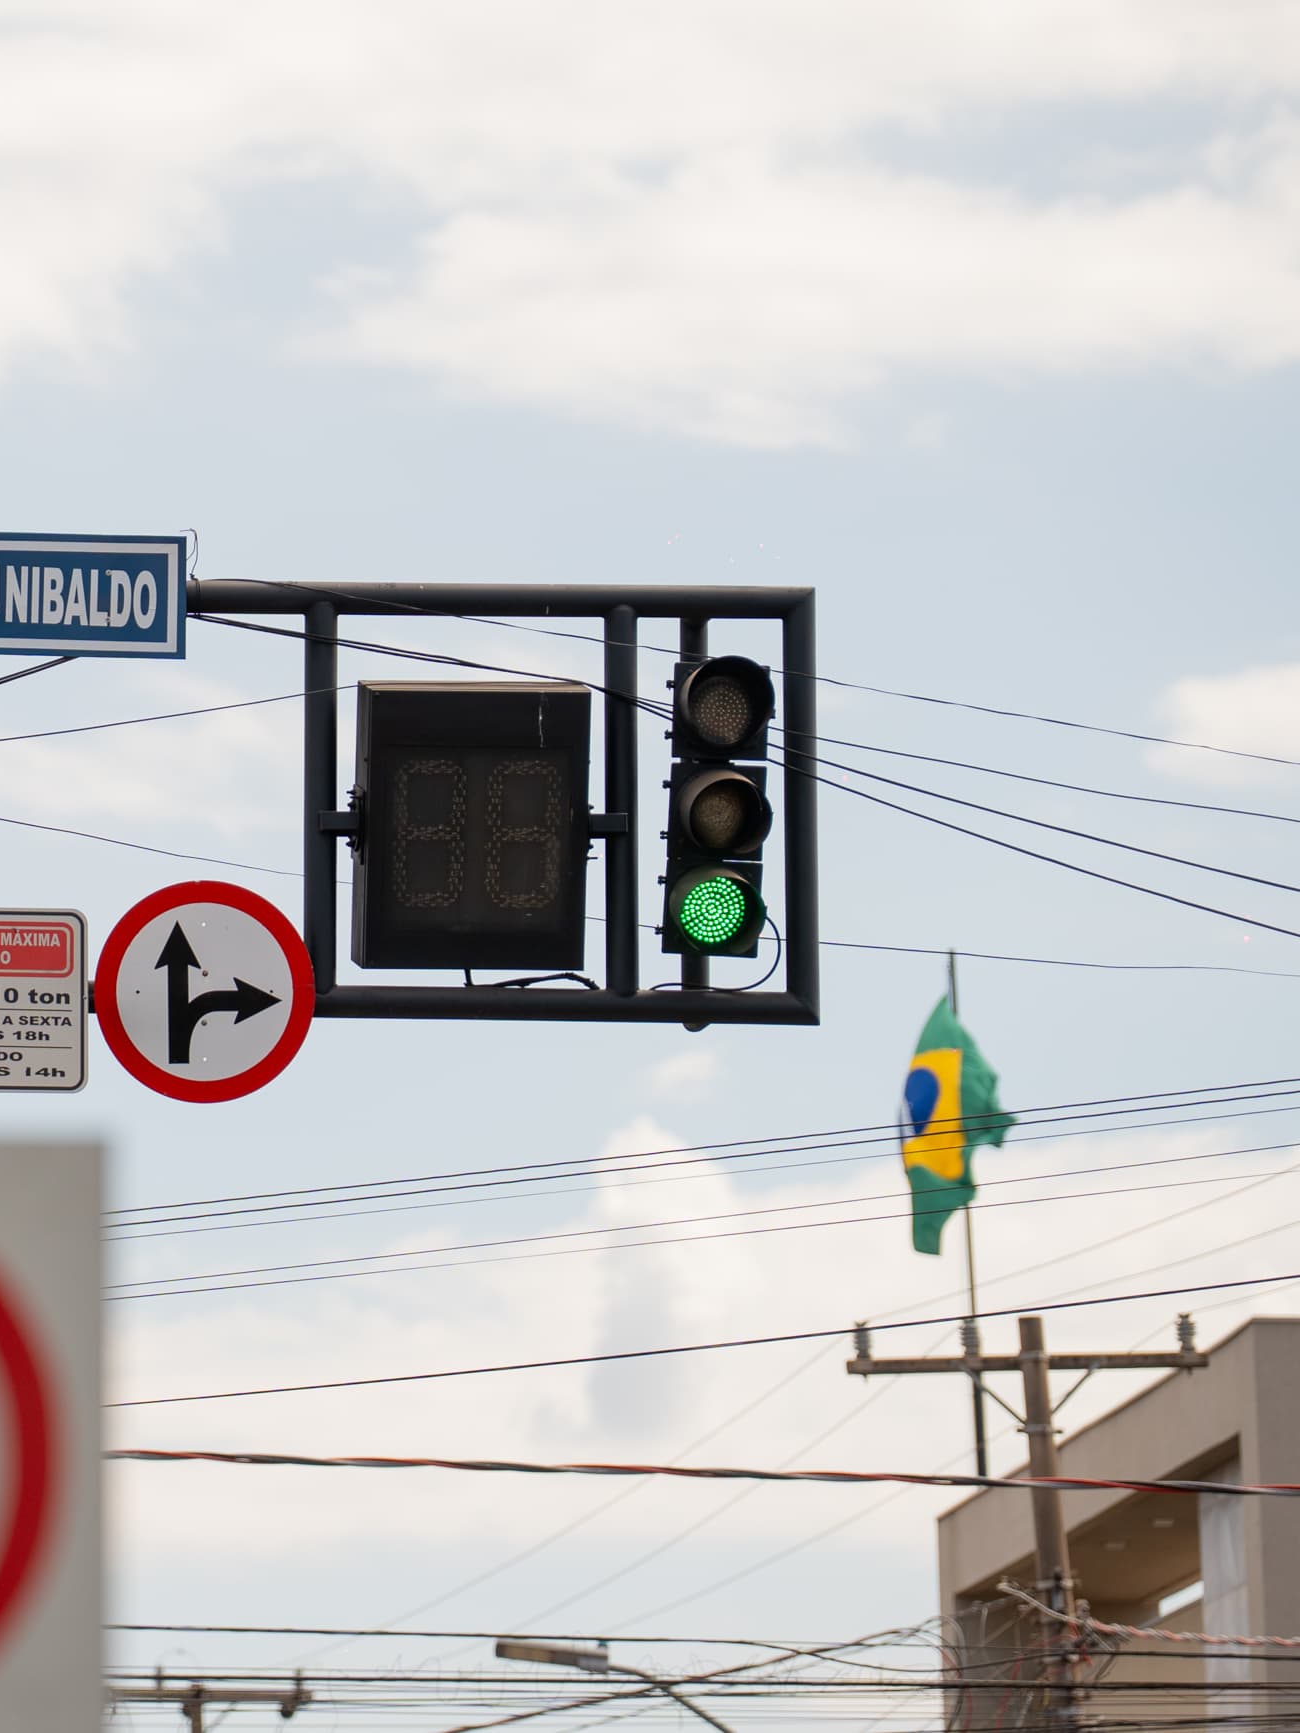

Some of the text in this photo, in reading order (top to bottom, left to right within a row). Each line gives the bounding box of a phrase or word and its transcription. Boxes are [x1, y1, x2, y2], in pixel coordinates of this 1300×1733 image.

[0, 929, 61, 947] MÁXIMA
[28, 989, 70, 1005] ton
[2, 1015, 13, 1025] A
[19, 1016, 72, 1026] SEXTA
[12, 1030, 50, 1041] 18h
[25, 1066, 65, 1077] 14h
